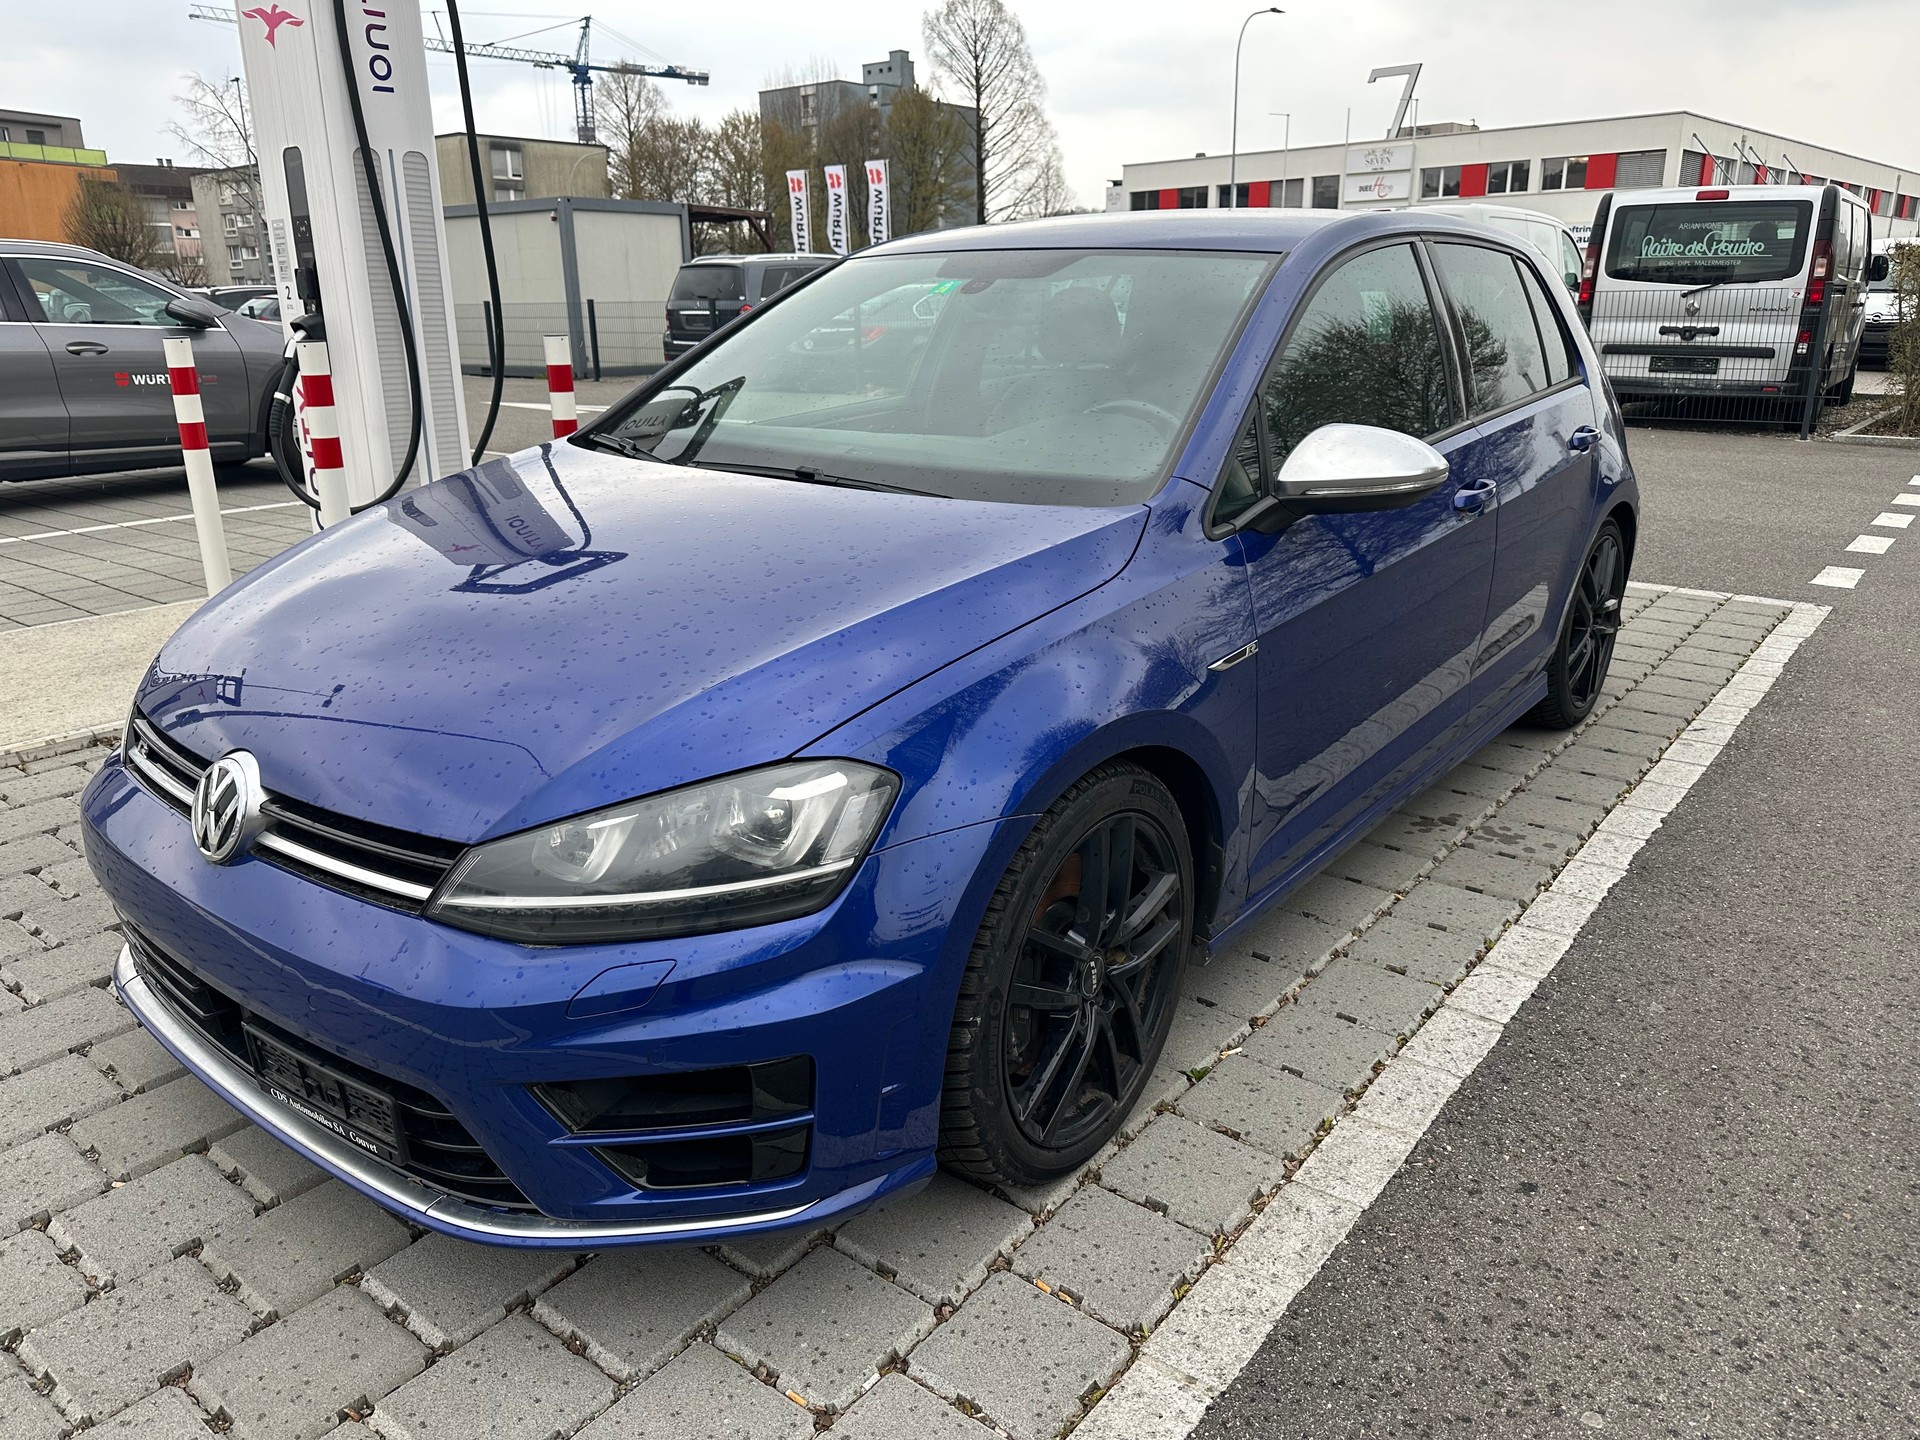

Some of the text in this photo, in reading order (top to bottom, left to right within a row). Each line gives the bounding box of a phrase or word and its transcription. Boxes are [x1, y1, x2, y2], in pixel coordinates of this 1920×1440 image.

[360, 0, 394, 93] IONI
[1364, 156, 1391, 167] SEVEN
[1678, 222, 1700, 230] ARIAN
[285, 285, 292, 300] 2
[131, 374, 171, 385] WÜRT
[270, 1088, 378, 1153] CDS Automobiles SA Couvet
